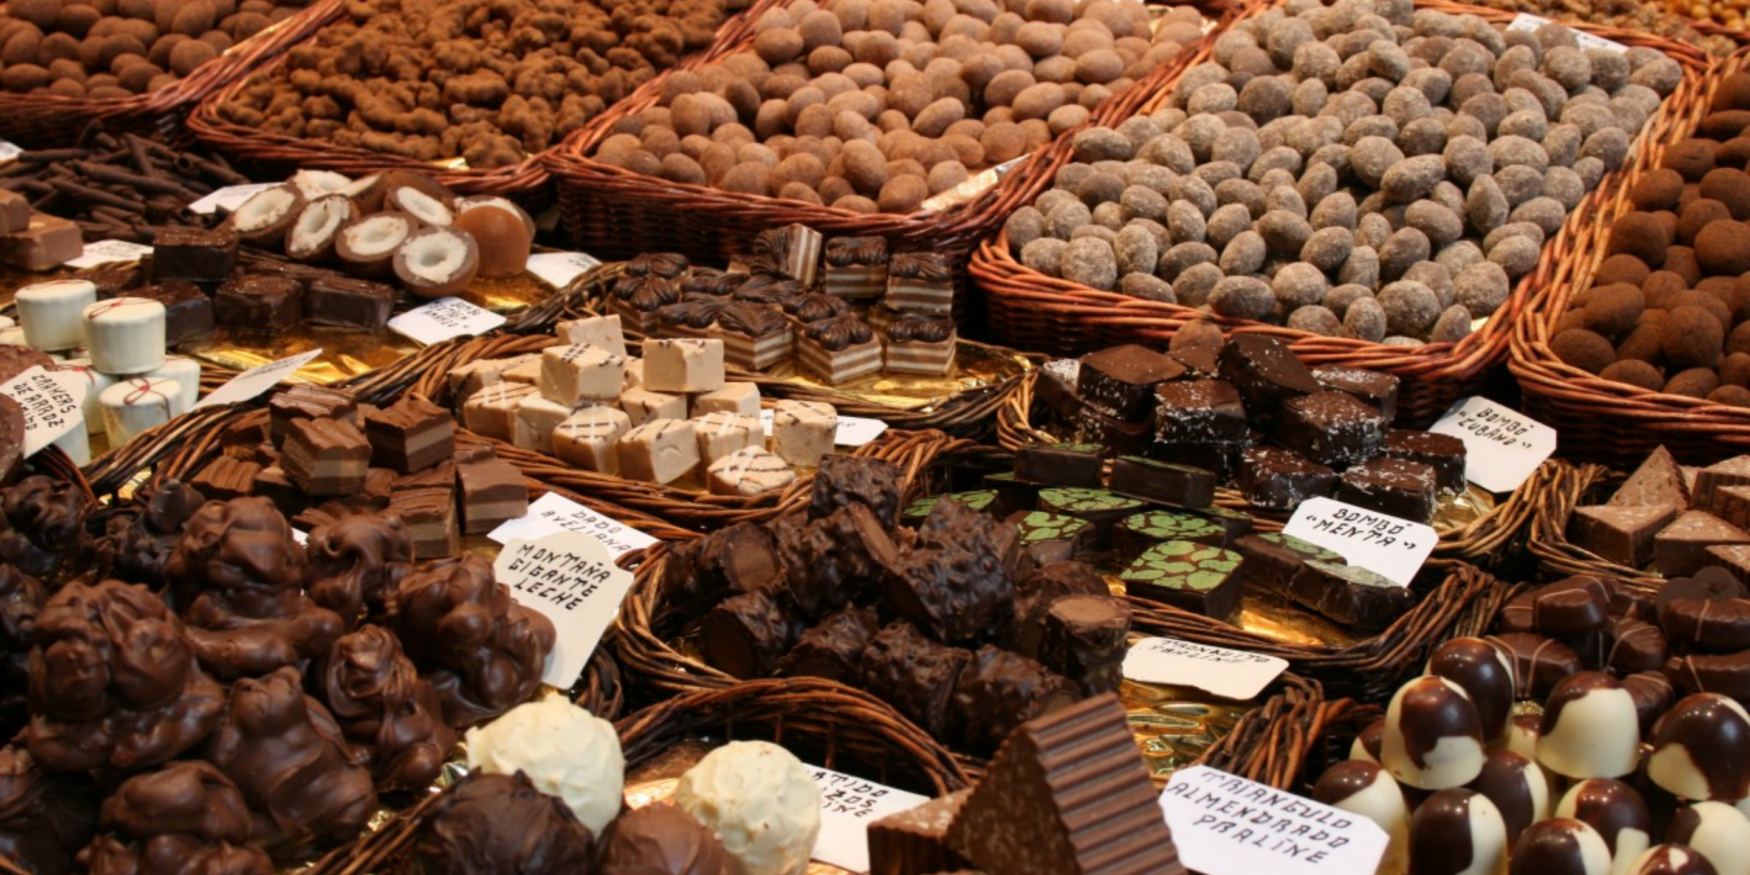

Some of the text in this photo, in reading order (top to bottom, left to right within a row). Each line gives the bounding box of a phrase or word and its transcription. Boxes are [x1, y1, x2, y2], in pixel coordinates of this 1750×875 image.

[13, 381, 34, 396] DE
[23, 394, 65, 428] ARROZ
[571, 510, 622, 534] DADO
[508, 558, 598, 597] GIGANTE
[516, 544, 611, 583] MONTAÑA
[514, 578, 583, 611] LECHE
[1167, 782, 1350, 849] ALMENDRADO
